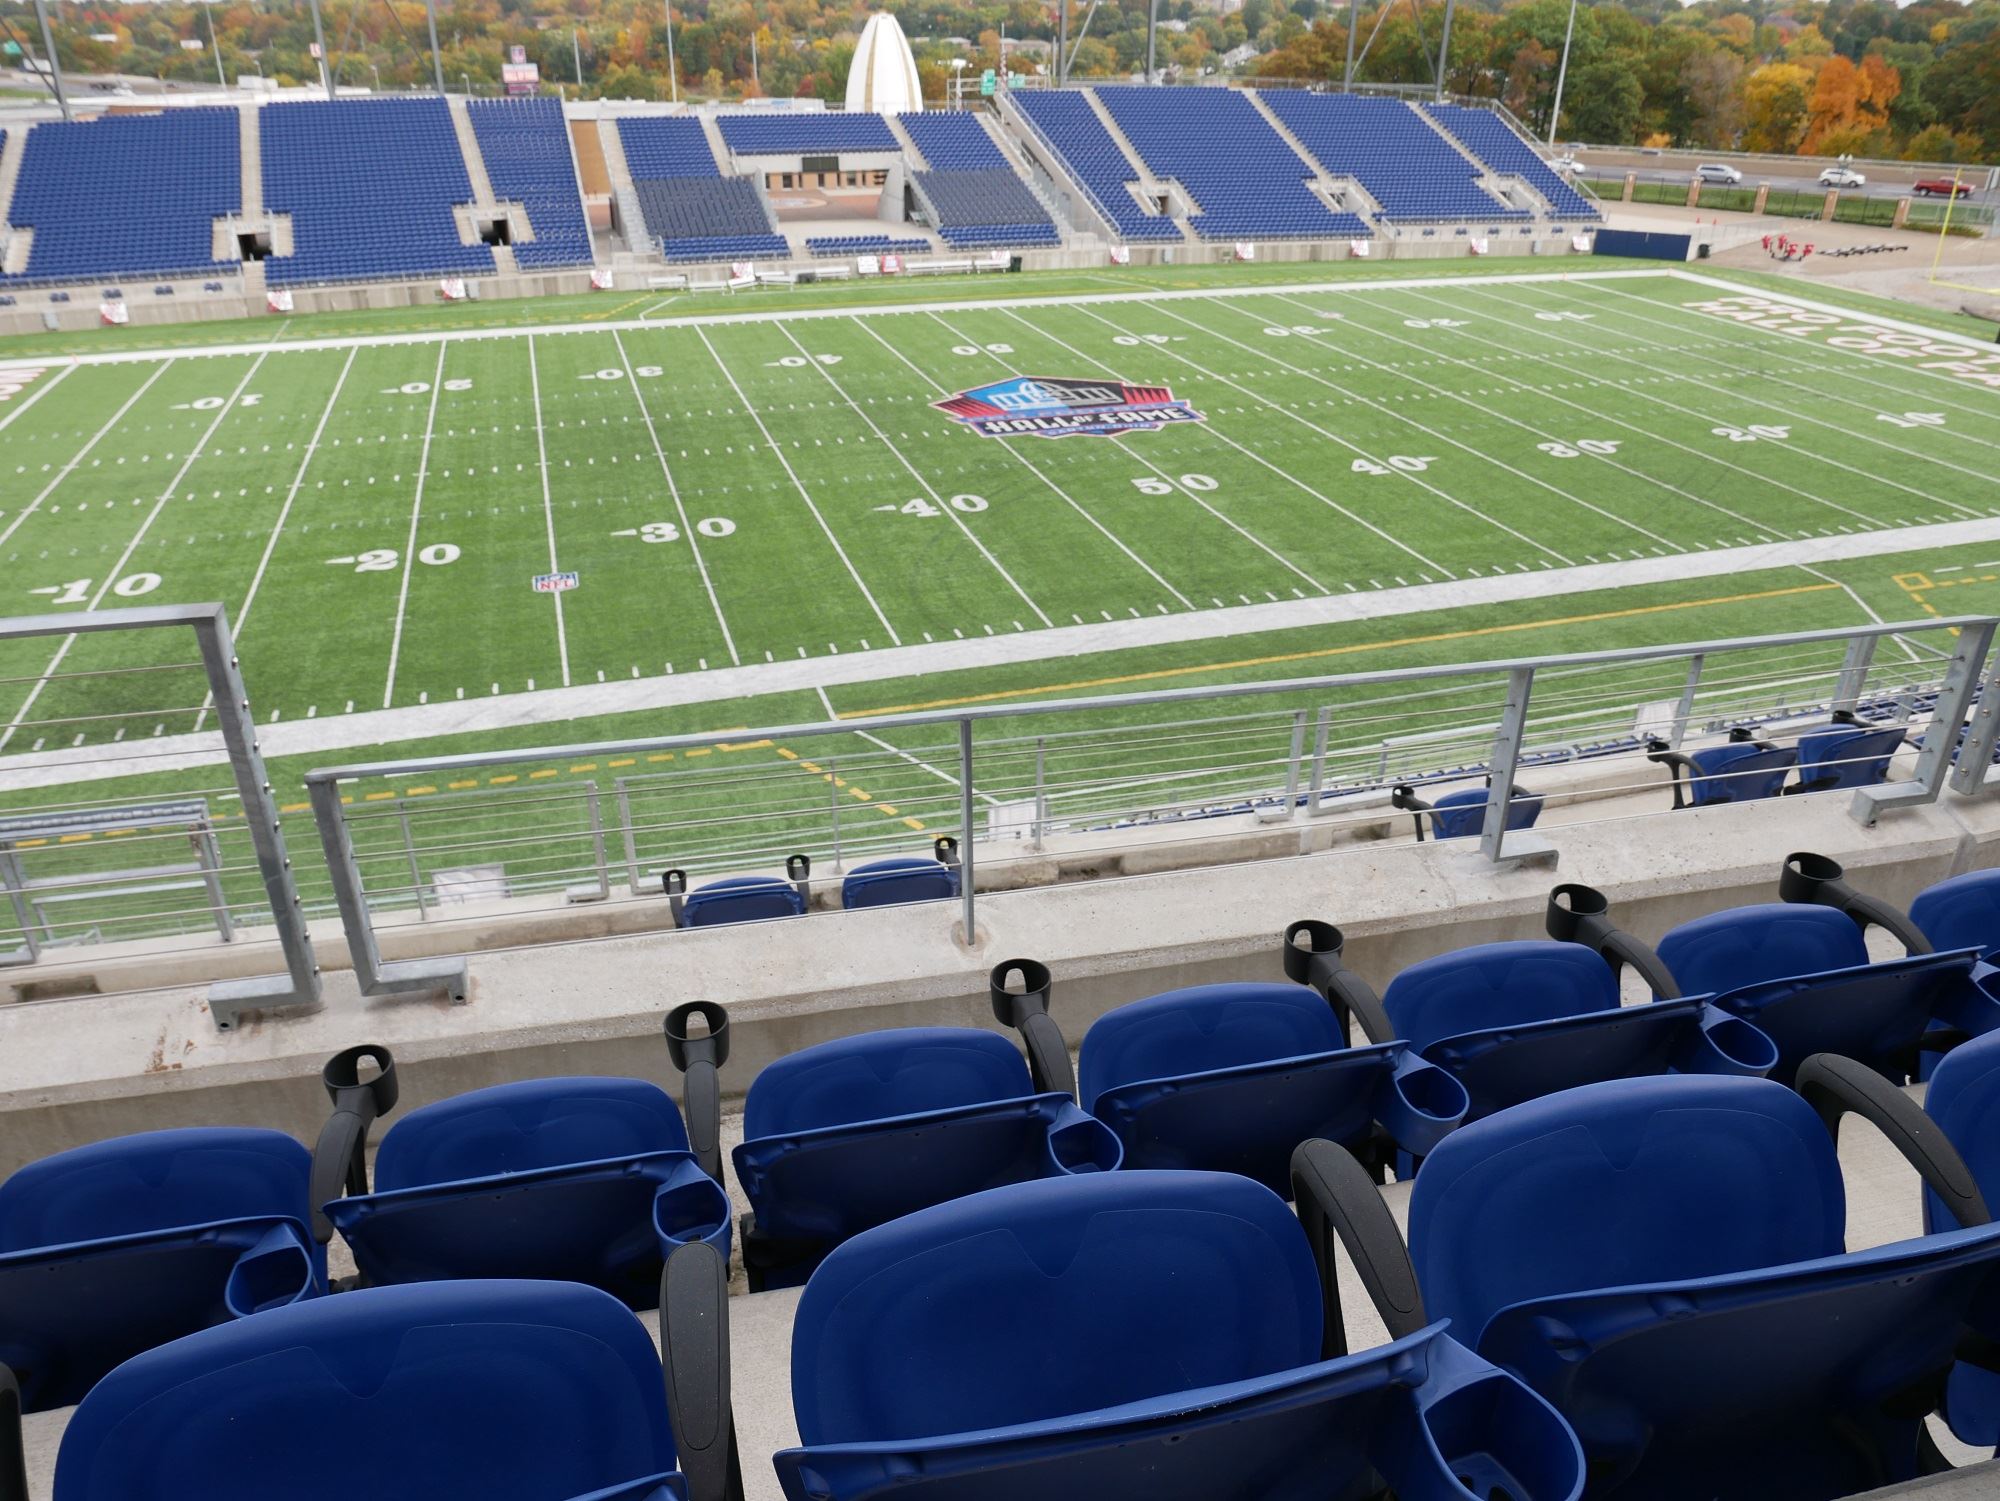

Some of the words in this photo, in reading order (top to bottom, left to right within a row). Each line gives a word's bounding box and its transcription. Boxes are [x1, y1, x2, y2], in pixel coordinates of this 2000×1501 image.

[1718, 297, 1841, 324] PRO
[1681, 301, 1825, 336] HALL
[1826, 336, 1929, 358] OF
[985, 416, 1079, 434] HALL
[1072, 415, 1093, 424] OF
[1098, 407, 1185, 424] FAME
[540, 580, 571, 591] NFL
